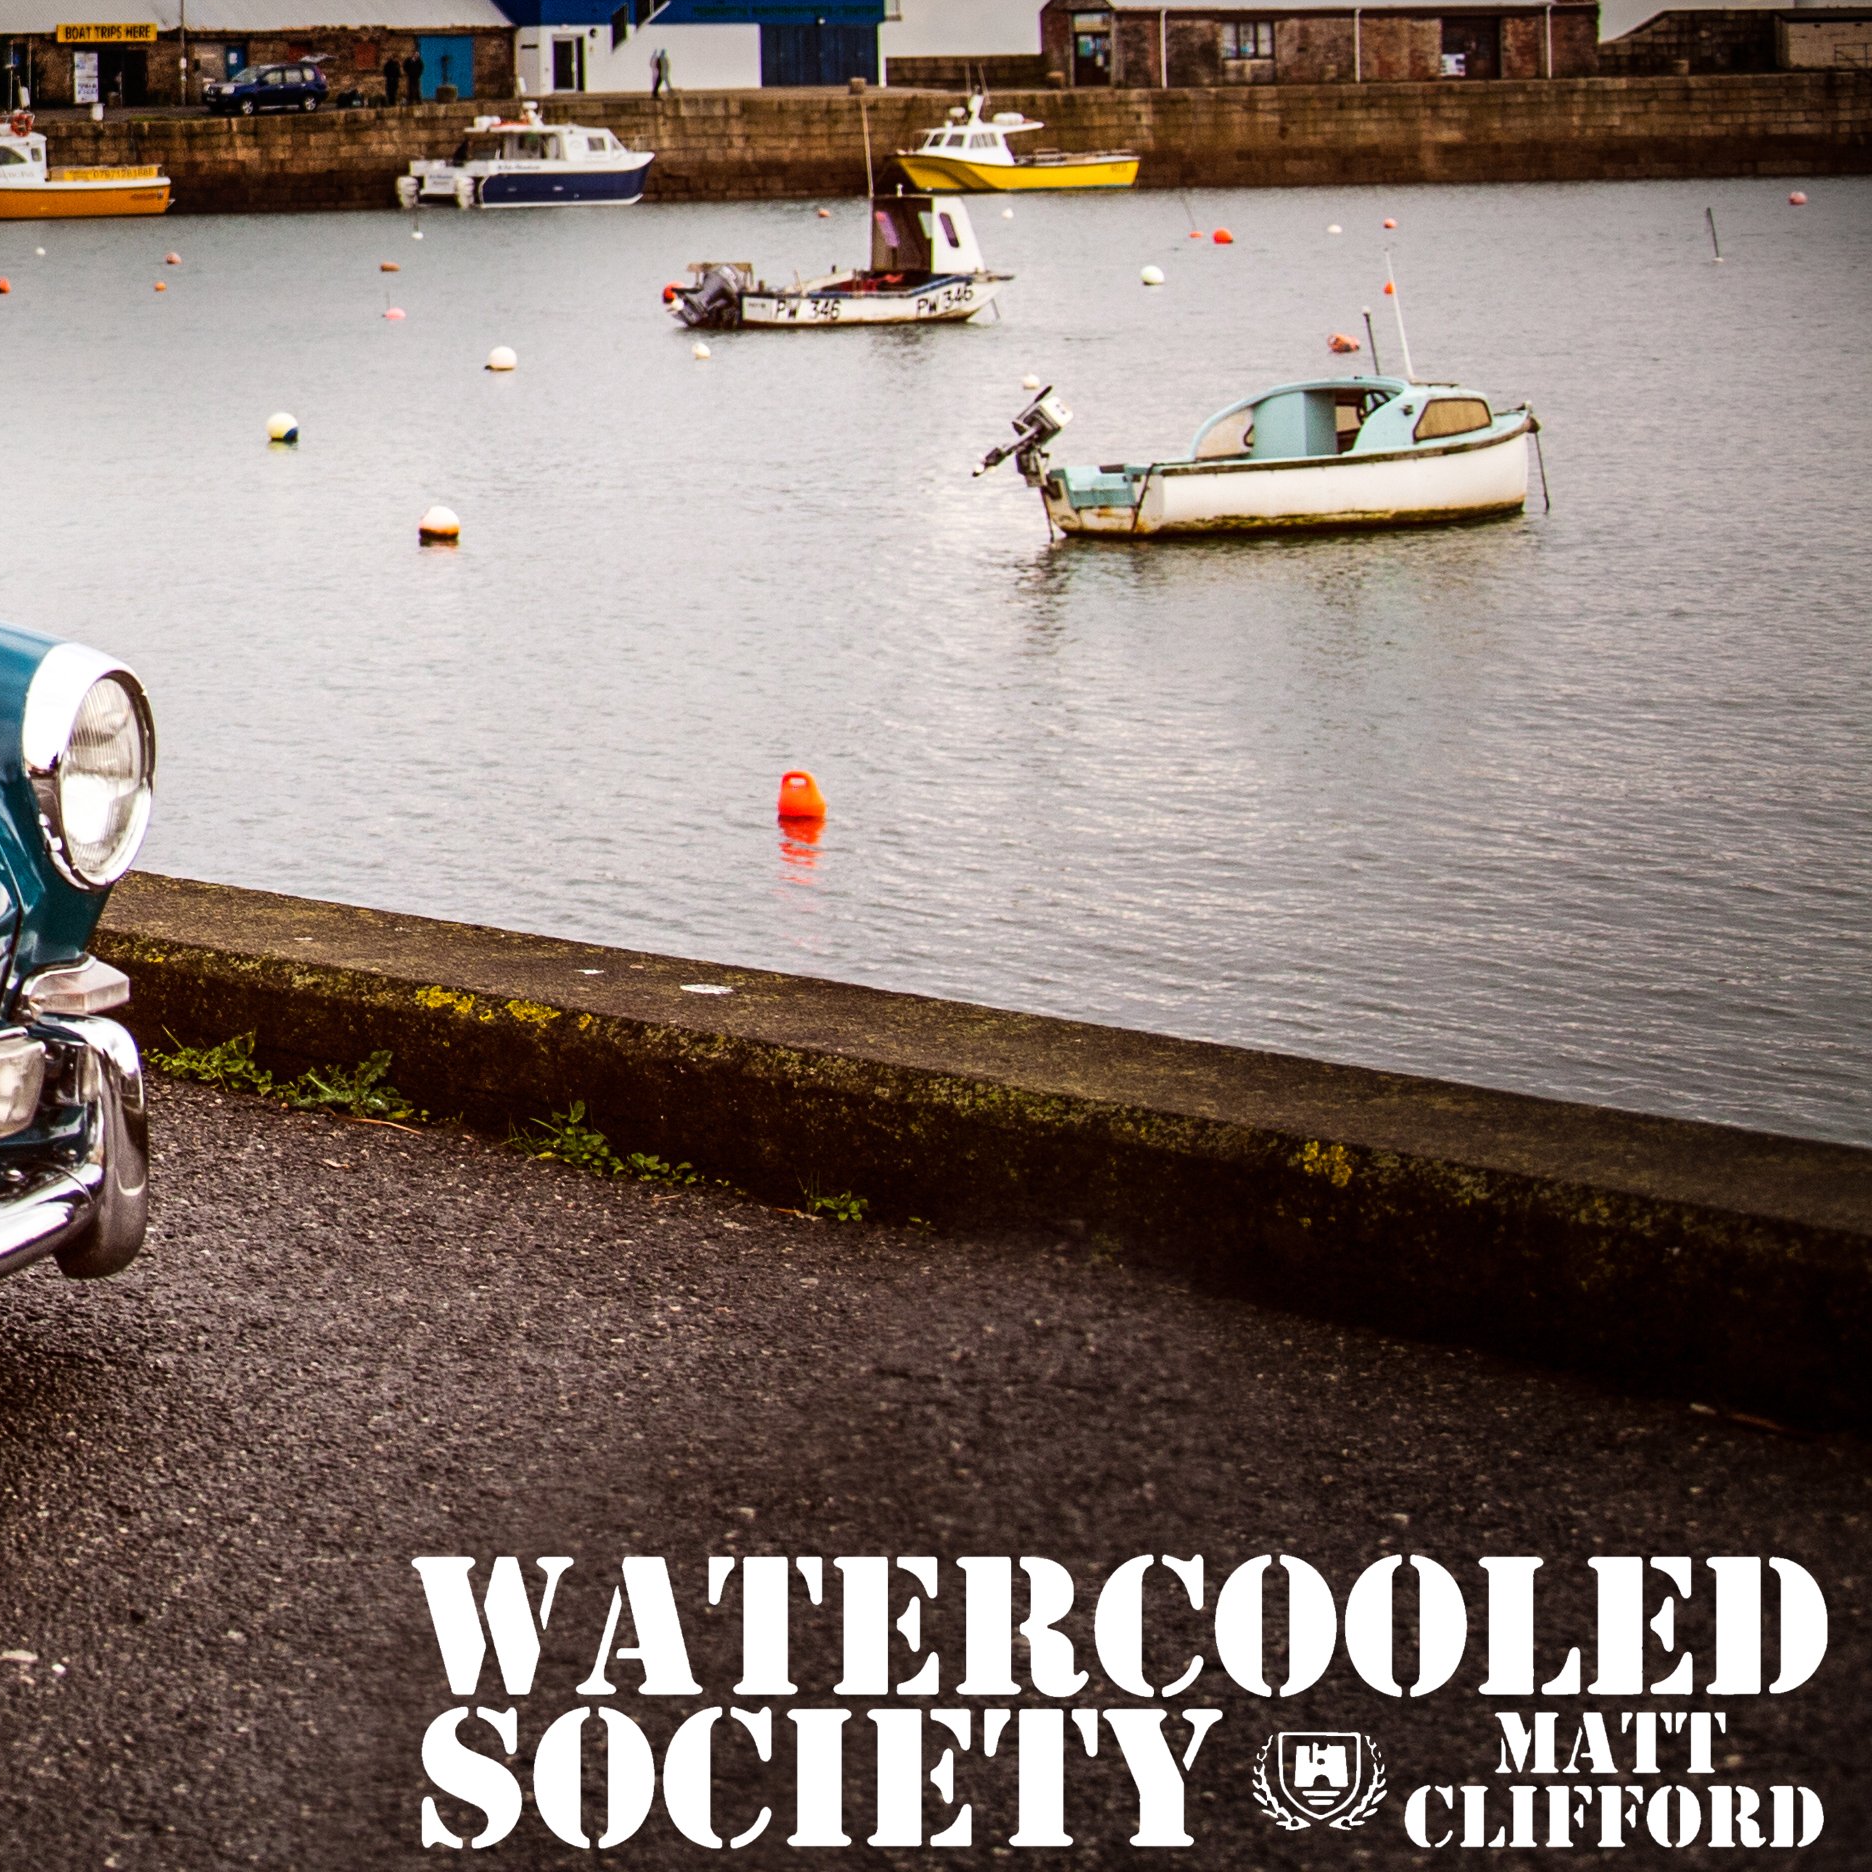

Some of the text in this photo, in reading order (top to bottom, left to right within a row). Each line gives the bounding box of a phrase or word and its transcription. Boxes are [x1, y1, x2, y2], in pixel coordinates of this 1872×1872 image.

[65, 24, 151, 40] BOAT TRIPS HERE
[776, 298, 840, 321] PW 346
[916, 280, 974, 318] PW 346
